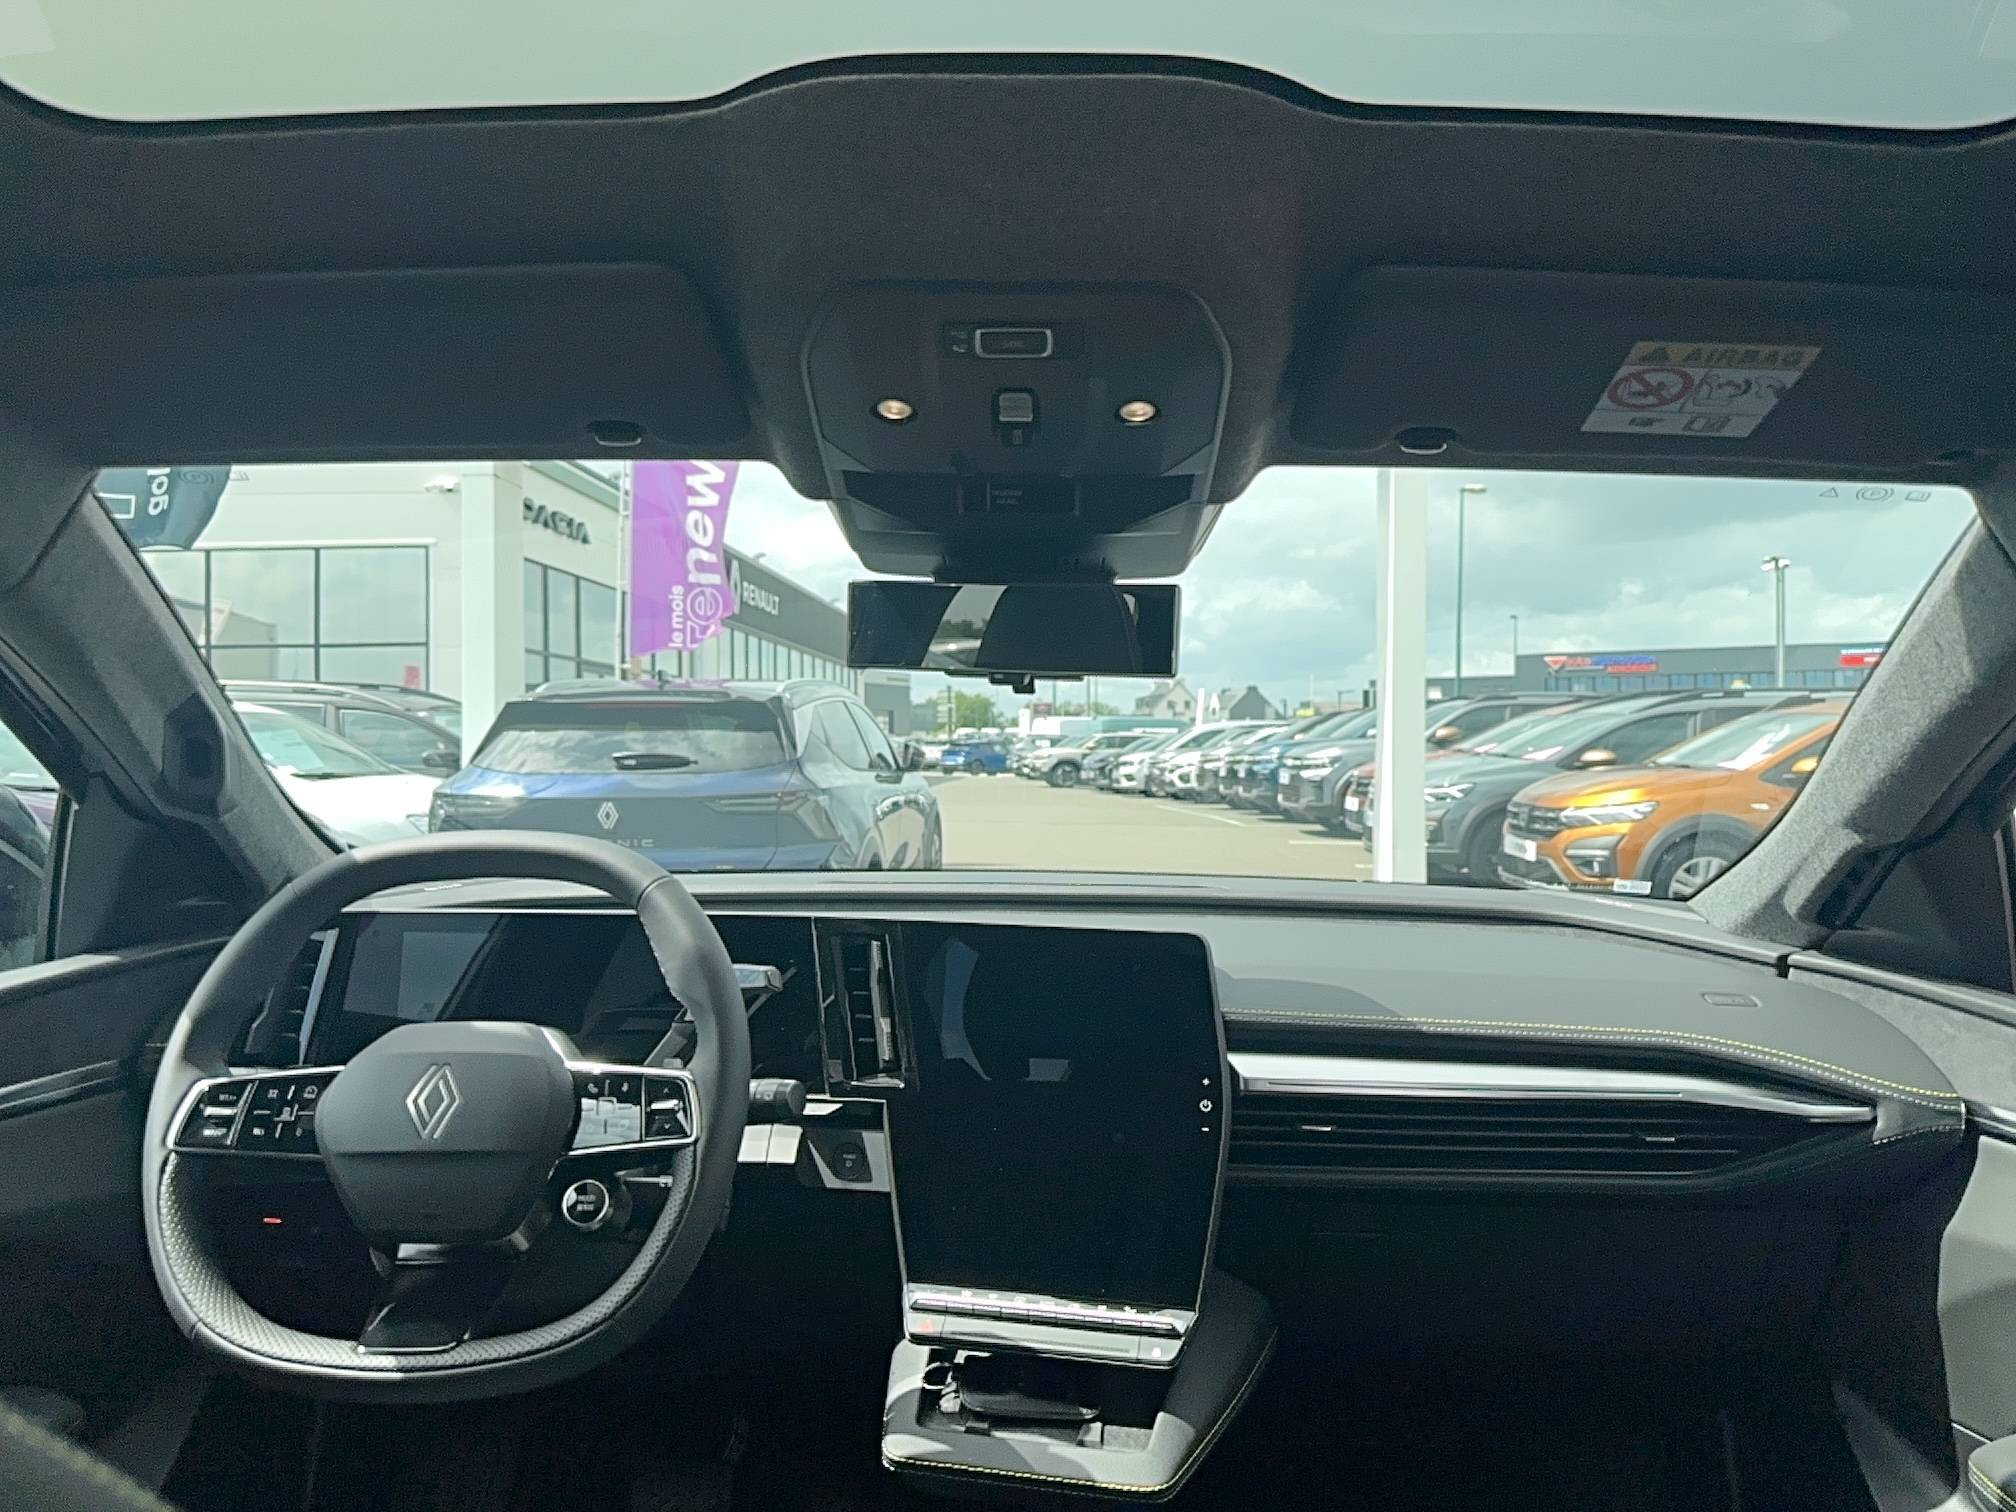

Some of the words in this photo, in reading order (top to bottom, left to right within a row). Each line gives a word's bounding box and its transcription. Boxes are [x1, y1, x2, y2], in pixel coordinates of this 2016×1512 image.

[1682, 347, 1804, 366] AIRBAG
[668, 585, 684, 629] mois
[742, 581, 780, 616] RENAULT
[668, 631, 684, 647] le
